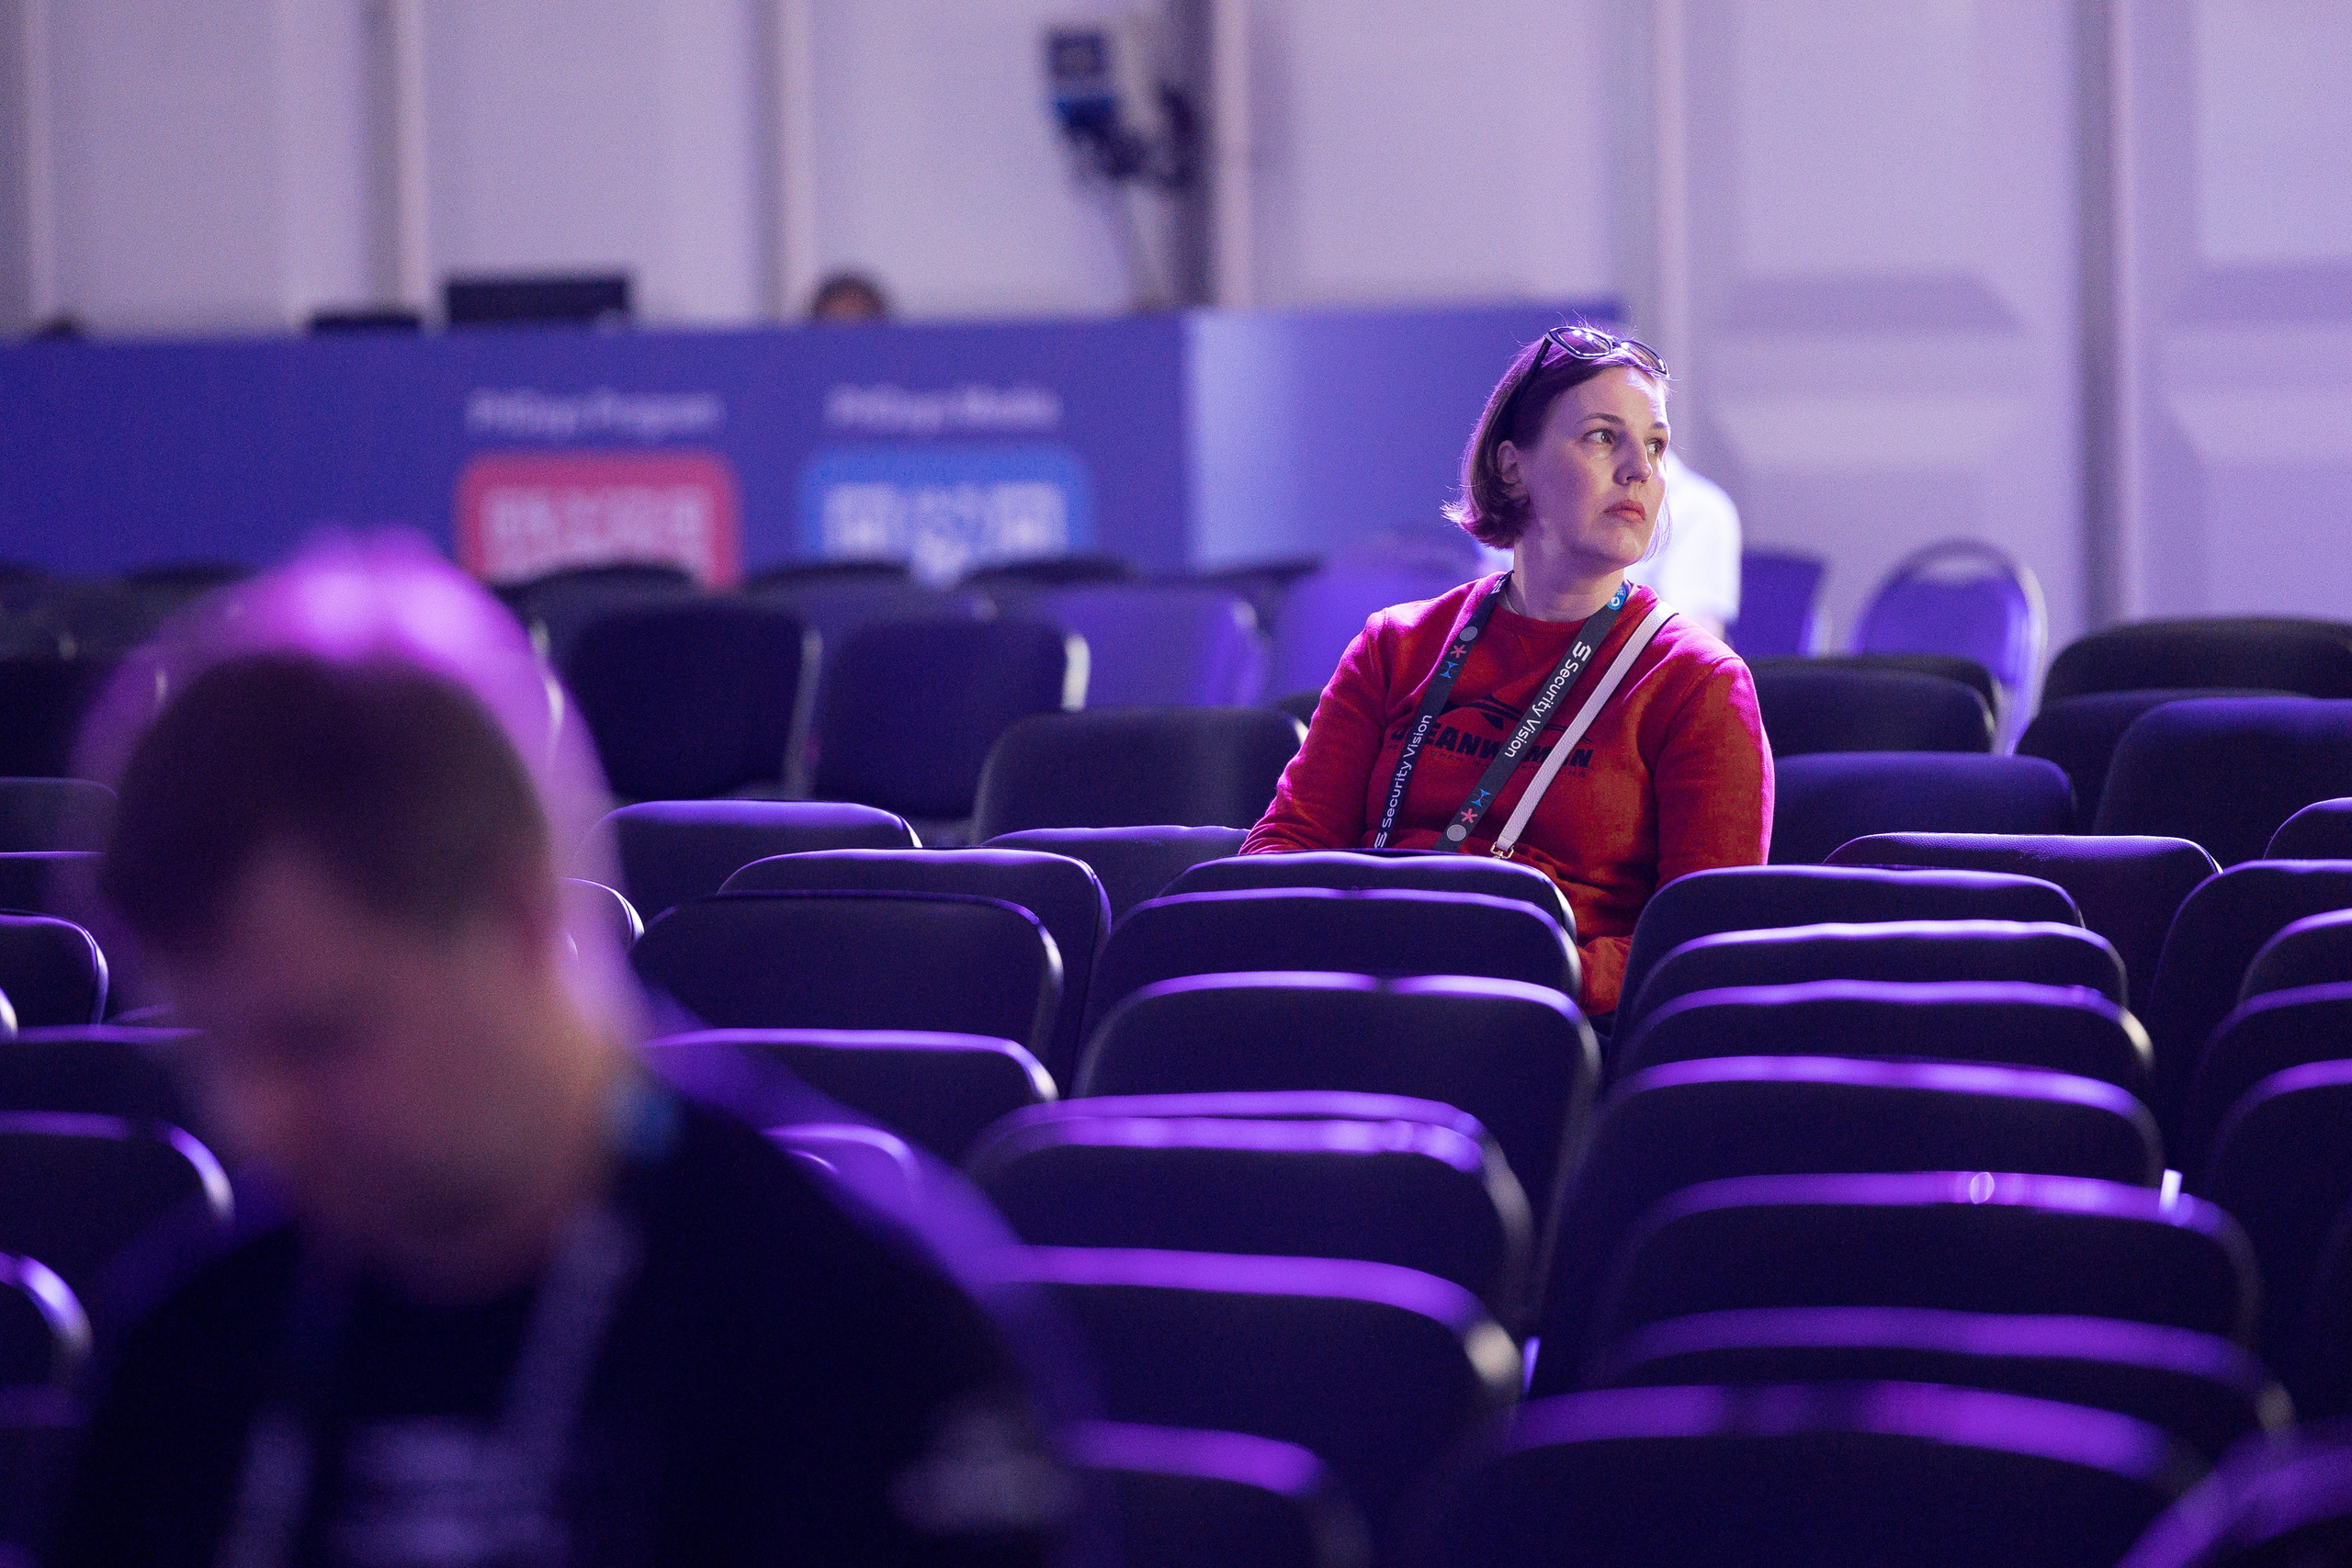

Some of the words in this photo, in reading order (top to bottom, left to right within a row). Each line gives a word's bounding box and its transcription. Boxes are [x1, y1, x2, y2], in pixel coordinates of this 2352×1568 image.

[1532, 660, 1579, 717] Security
[1504, 718, 1541, 758] Vision
[1382, 761, 1412, 828] Security
[1403, 715, 1433, 757] Vision
